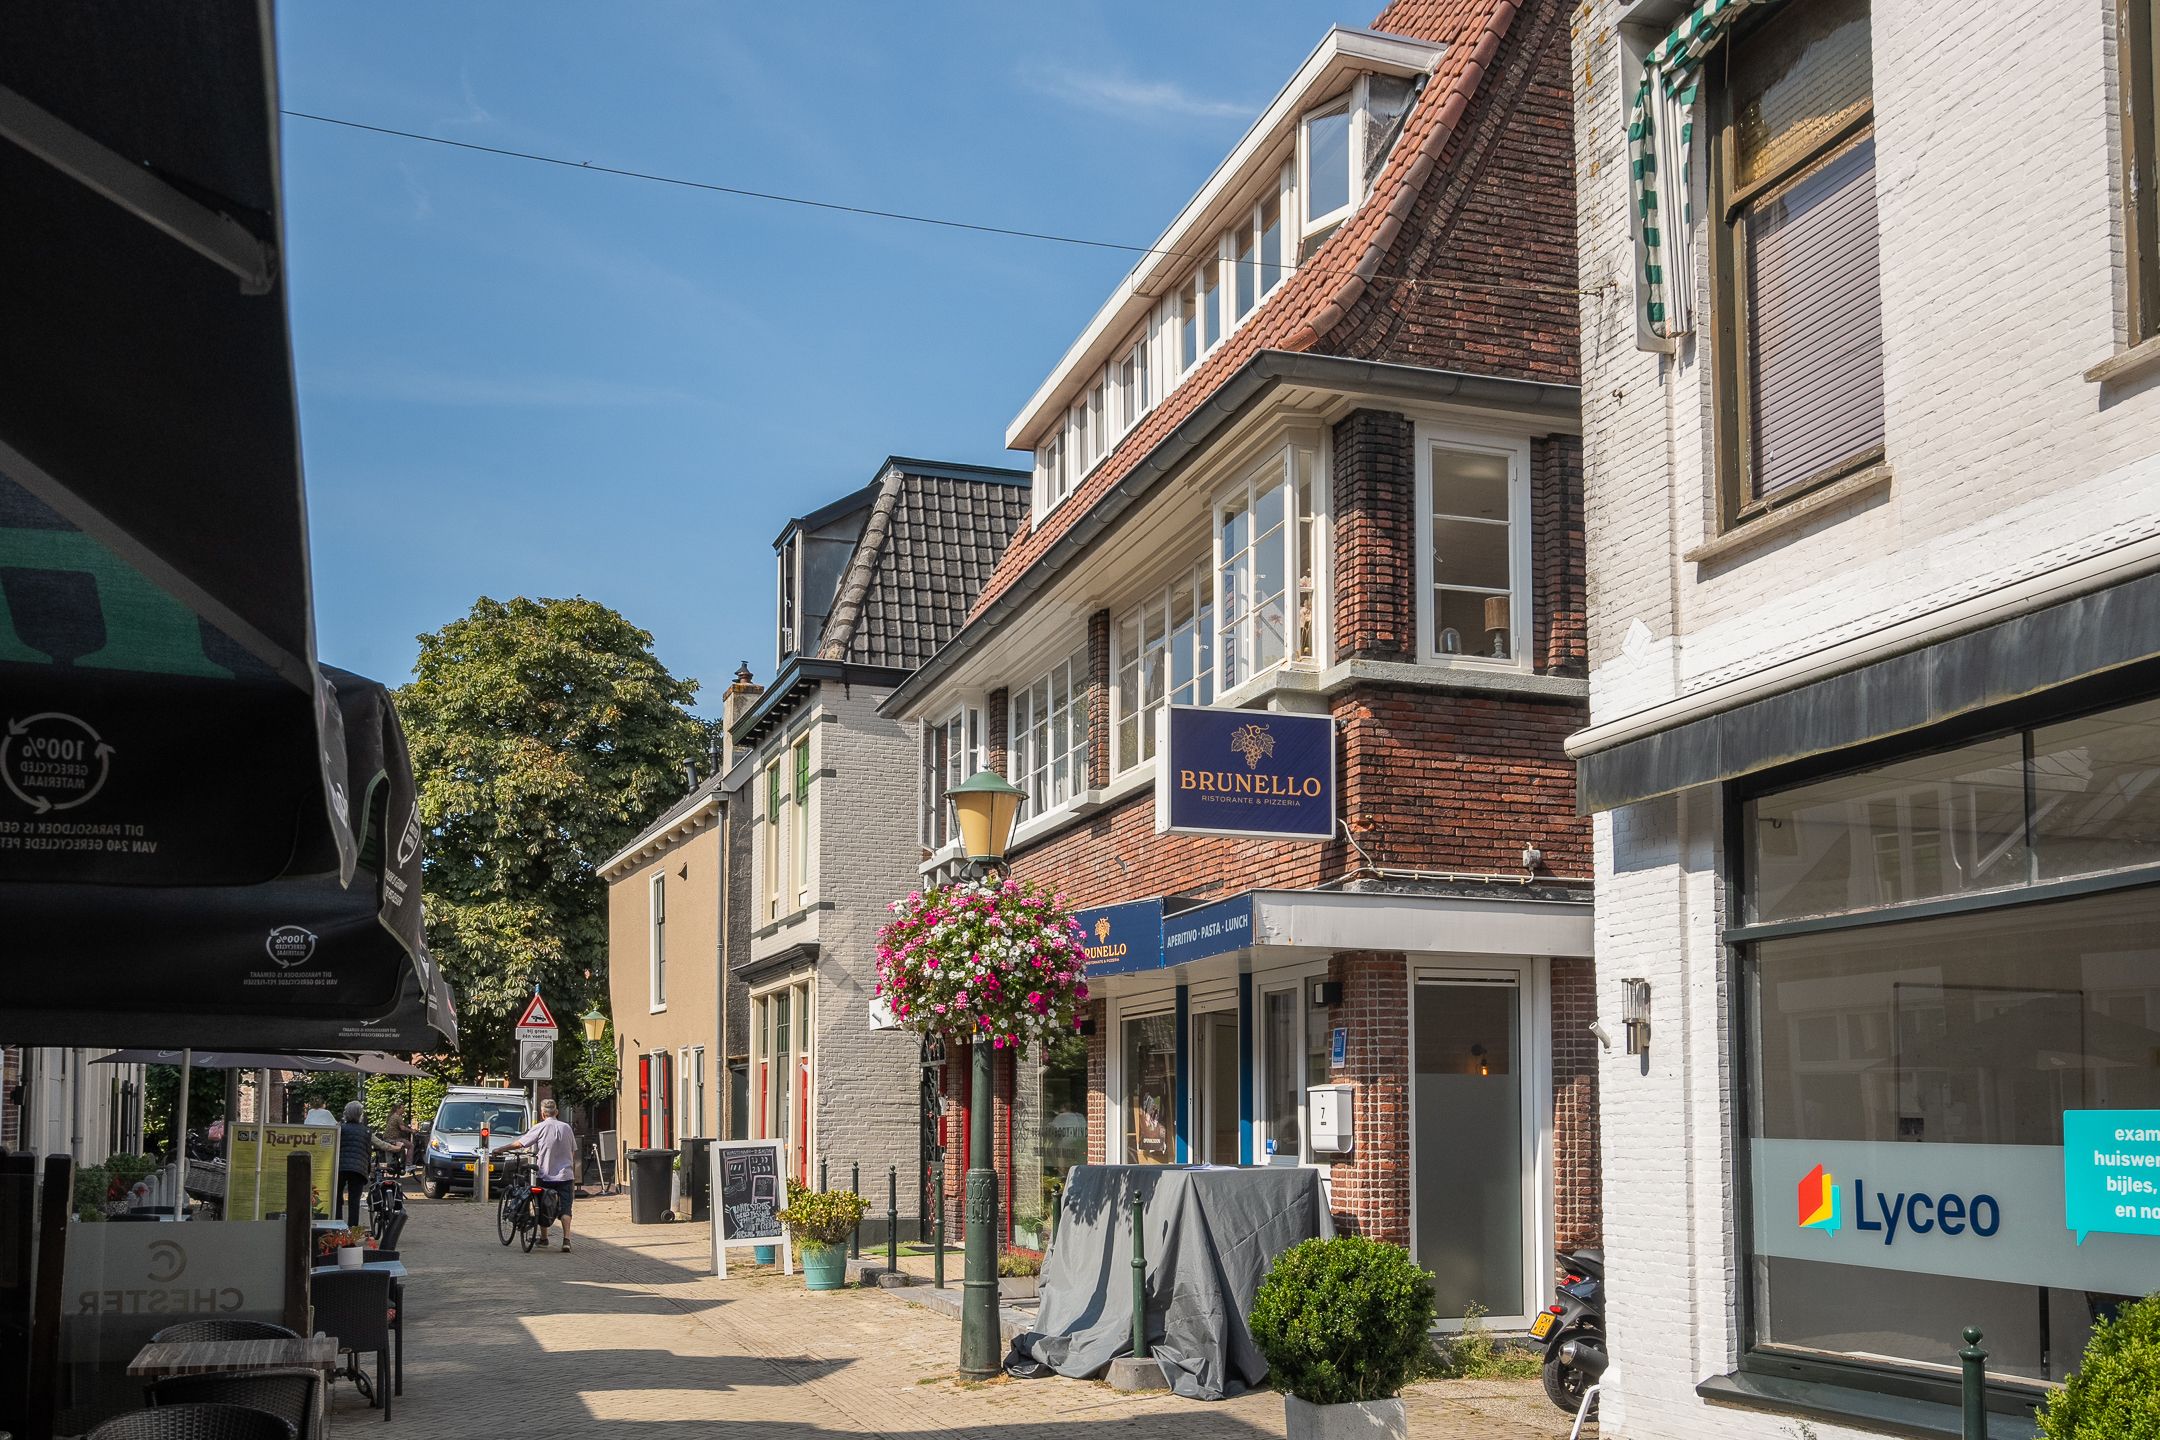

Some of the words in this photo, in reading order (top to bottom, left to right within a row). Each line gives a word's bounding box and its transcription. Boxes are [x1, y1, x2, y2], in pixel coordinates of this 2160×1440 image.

[1180, 770, 1321, 797] BRUNELLO
[1202, 795, 1253, 805] RISTORANTE
[1264, 798, 1301, 807] PIZZERIA
[1167, 929, 1197, 948] APERITIVO
[1200, 923, 1221, 939] PASTA
[1225, 914, 1248, 932] LUNCH
[1085, 943, 1127, 958] RUNELLO
[1321, 1107, 1325, 1119] 7
[2106, 1176, 2158, 1195] bijles,
[1855, 1178, 2000, 1246] Lyceo
[2115, 1205, 2136, 1218] en
